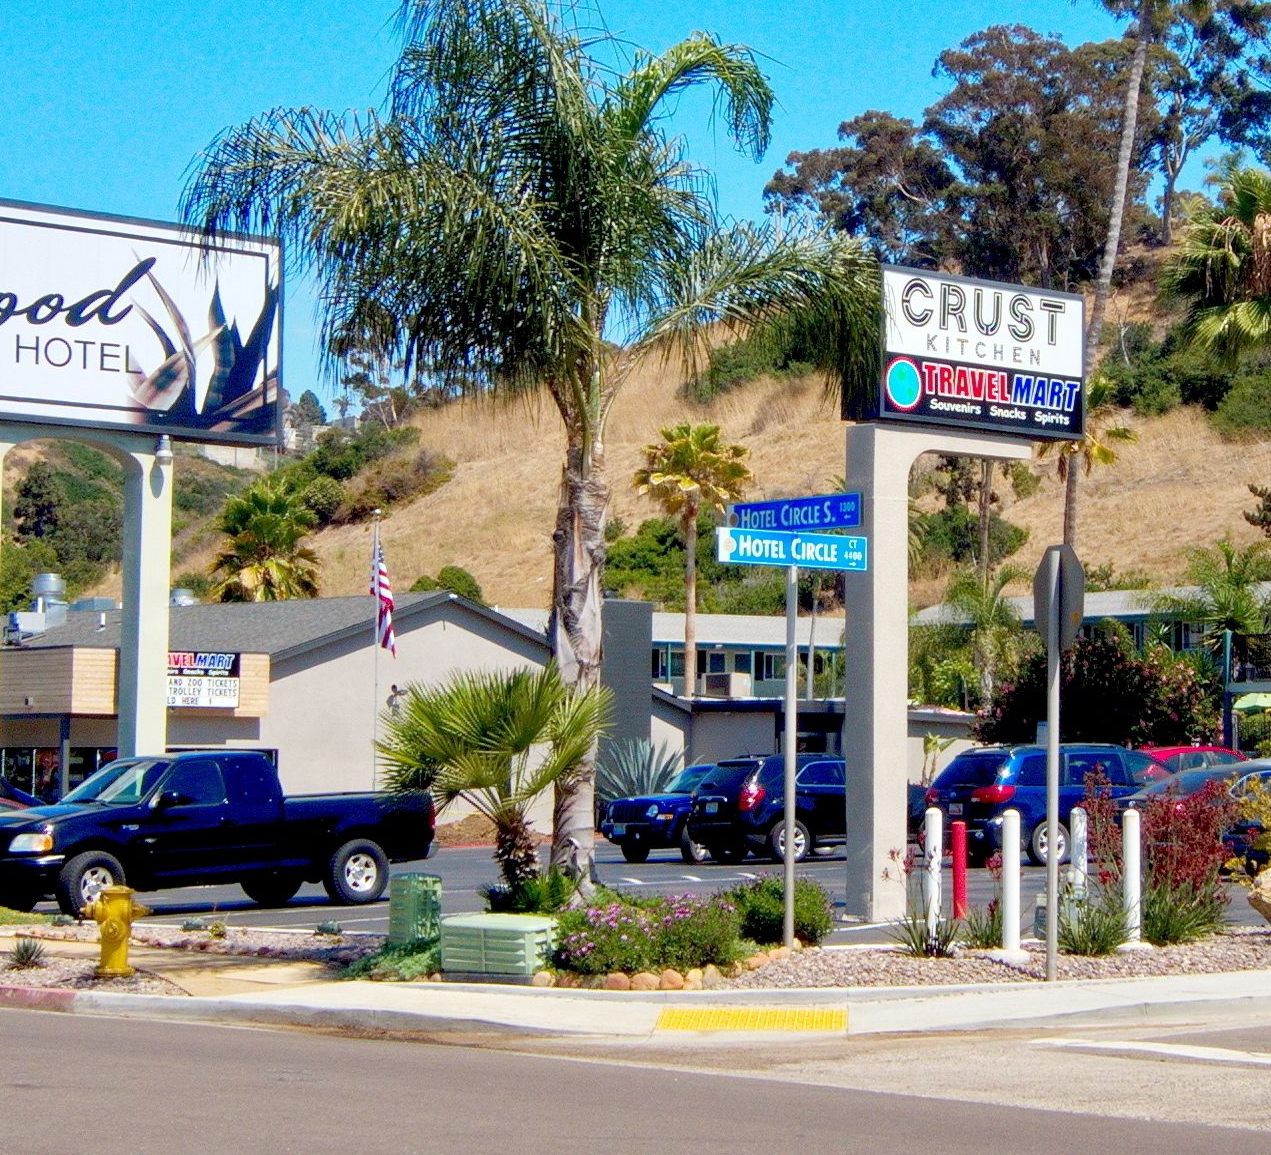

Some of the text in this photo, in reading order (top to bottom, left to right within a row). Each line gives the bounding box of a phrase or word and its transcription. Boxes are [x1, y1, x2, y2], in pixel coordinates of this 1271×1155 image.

[901, 277, 1066, 346] CRUST
[14, 334, 142, 374] HOTEL
[926, 333, 1041, 366] KITCHEN
[929, 398, 1070, 426] Souvenirs Snacks Spirits
[740, 501, 836, 529] HOTEL CIRCLE S.
[738, 534, 838, 562] HOTEL CIRCLE
[168, 678, 238, 688] AND ZOO TICKETS
[169, 687, 238, 698] TROLLEY TICKETS
[181, 697, 199, 705] HERE
